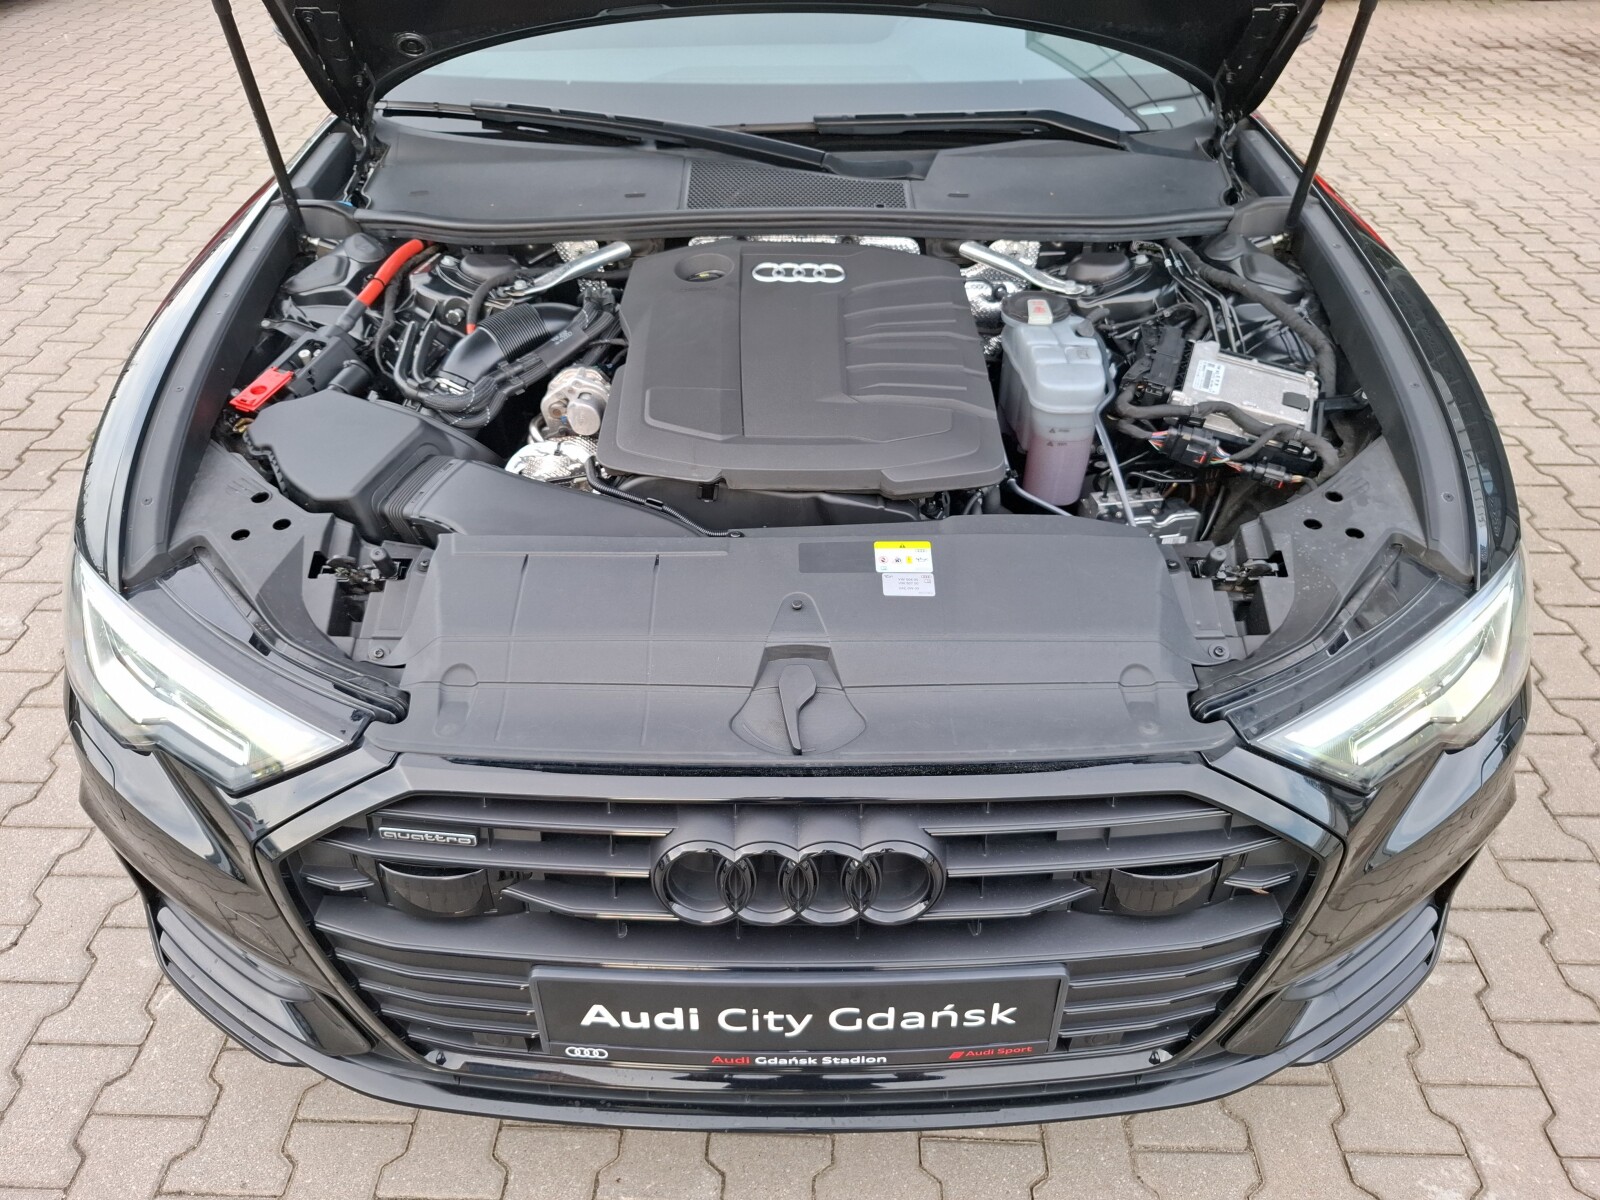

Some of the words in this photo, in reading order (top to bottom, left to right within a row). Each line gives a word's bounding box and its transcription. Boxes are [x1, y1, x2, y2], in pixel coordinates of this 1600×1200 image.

[382, 831, 472, 845] quattro
[580, 1004, 700, 1031] Audi
[717, 1008, 813, 1037] City
[828, 1003, 1018, 1032] Gdańsk
[966, 1047, 994, 1057] Audi
[1000, 1046, 1033, 1055] Sport
[711, 1056, 750, 1065] Audi
[754, 1055, 818, 1066] Gdańsk
[821, 1055, 887, 1066] Stadion
